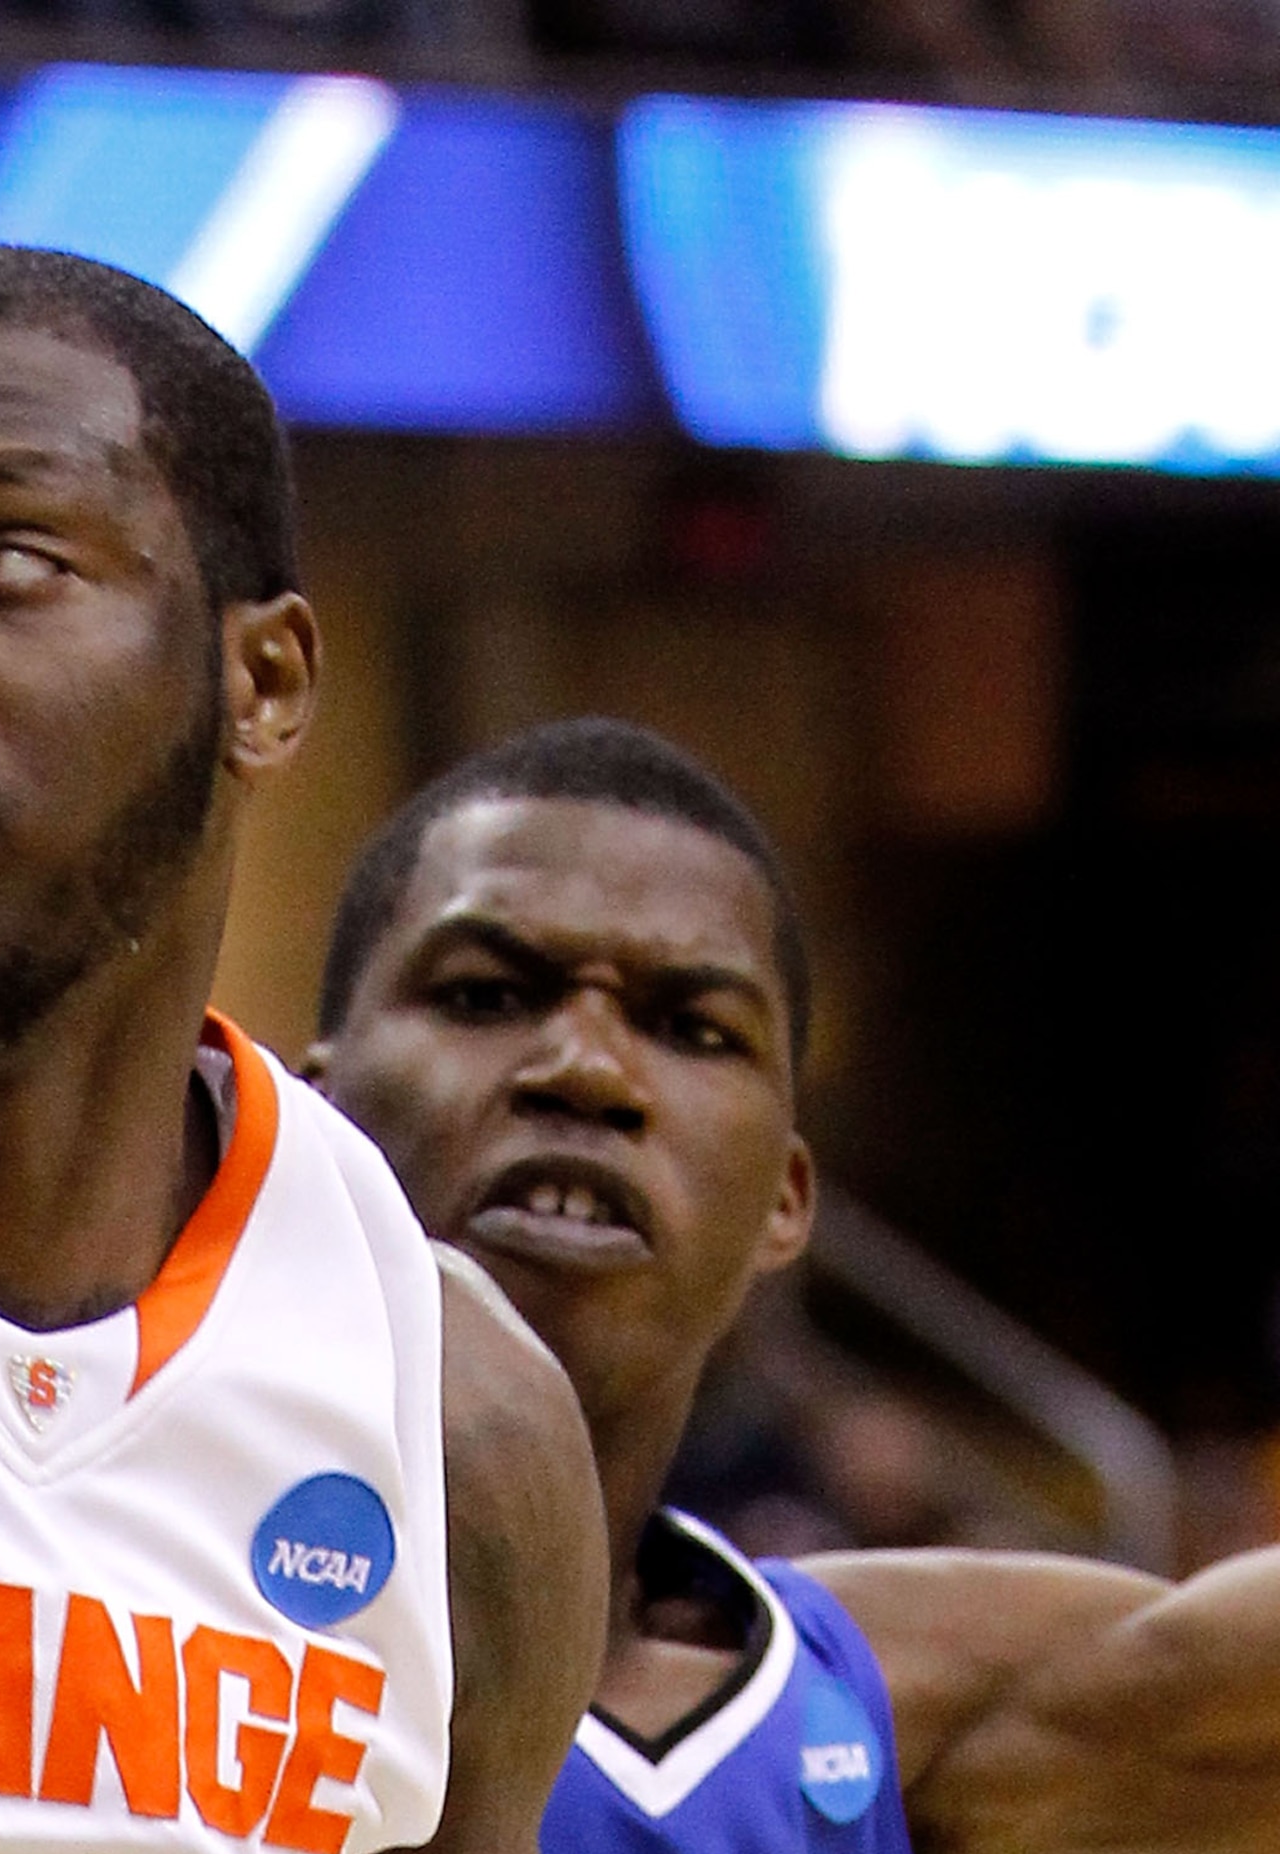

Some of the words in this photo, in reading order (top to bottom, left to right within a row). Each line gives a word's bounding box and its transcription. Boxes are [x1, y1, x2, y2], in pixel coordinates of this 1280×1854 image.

[28, 1359, 57, 1408] S
[268, 1537, 372, 1594] NCAA
[800, 1742, 869, 1784] NCAA
